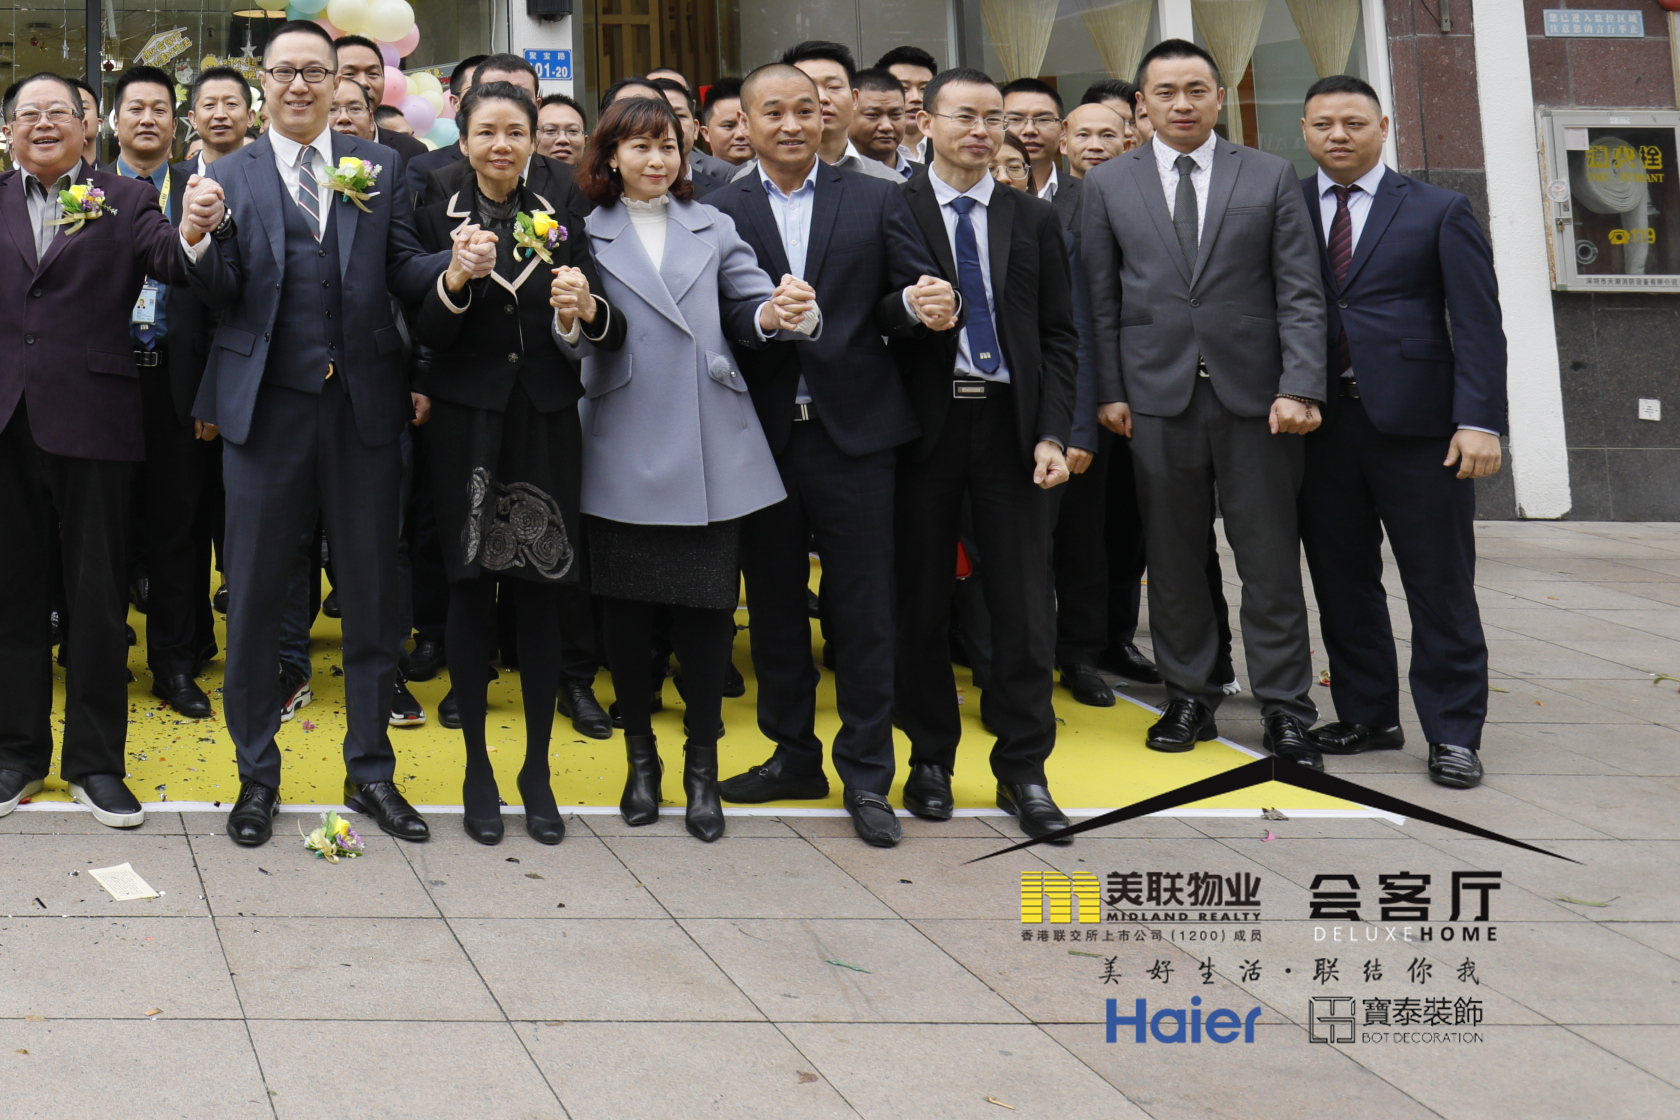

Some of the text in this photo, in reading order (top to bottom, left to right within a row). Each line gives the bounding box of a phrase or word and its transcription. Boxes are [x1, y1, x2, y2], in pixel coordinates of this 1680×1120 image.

[1549, 13, 1638, 23] 您已进入监控区域
[1549, 24, 1639, 34] 注意您的言行举止
[529, 52, 566, 60] 聚宝路
[530, 62, 568, 78] 01-20
[1585, 145, 1663, 170] 消火栓
[1630, 228, 1656, 244] 119
